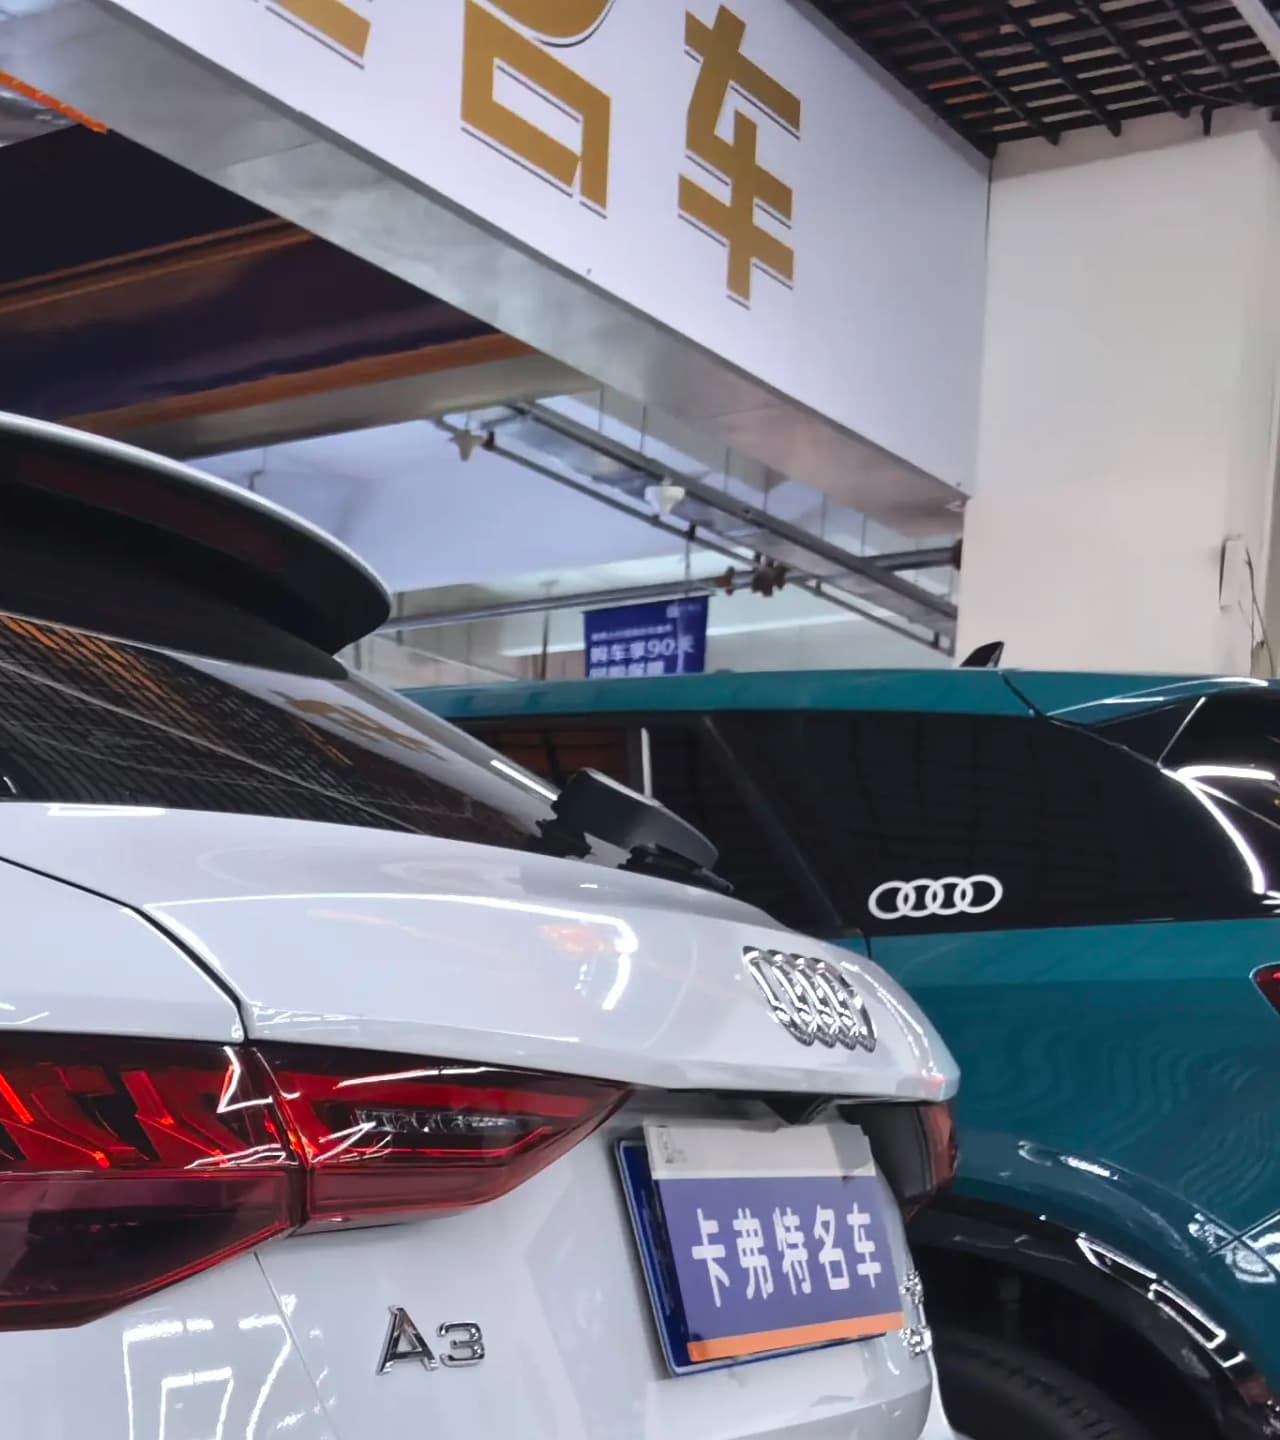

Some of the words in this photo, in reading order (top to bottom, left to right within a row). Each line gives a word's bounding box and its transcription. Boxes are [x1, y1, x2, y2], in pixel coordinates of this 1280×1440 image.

[691, 1202, 882, 1308] 卡弗特名车
[376, 1304, 485, 1376] A3
